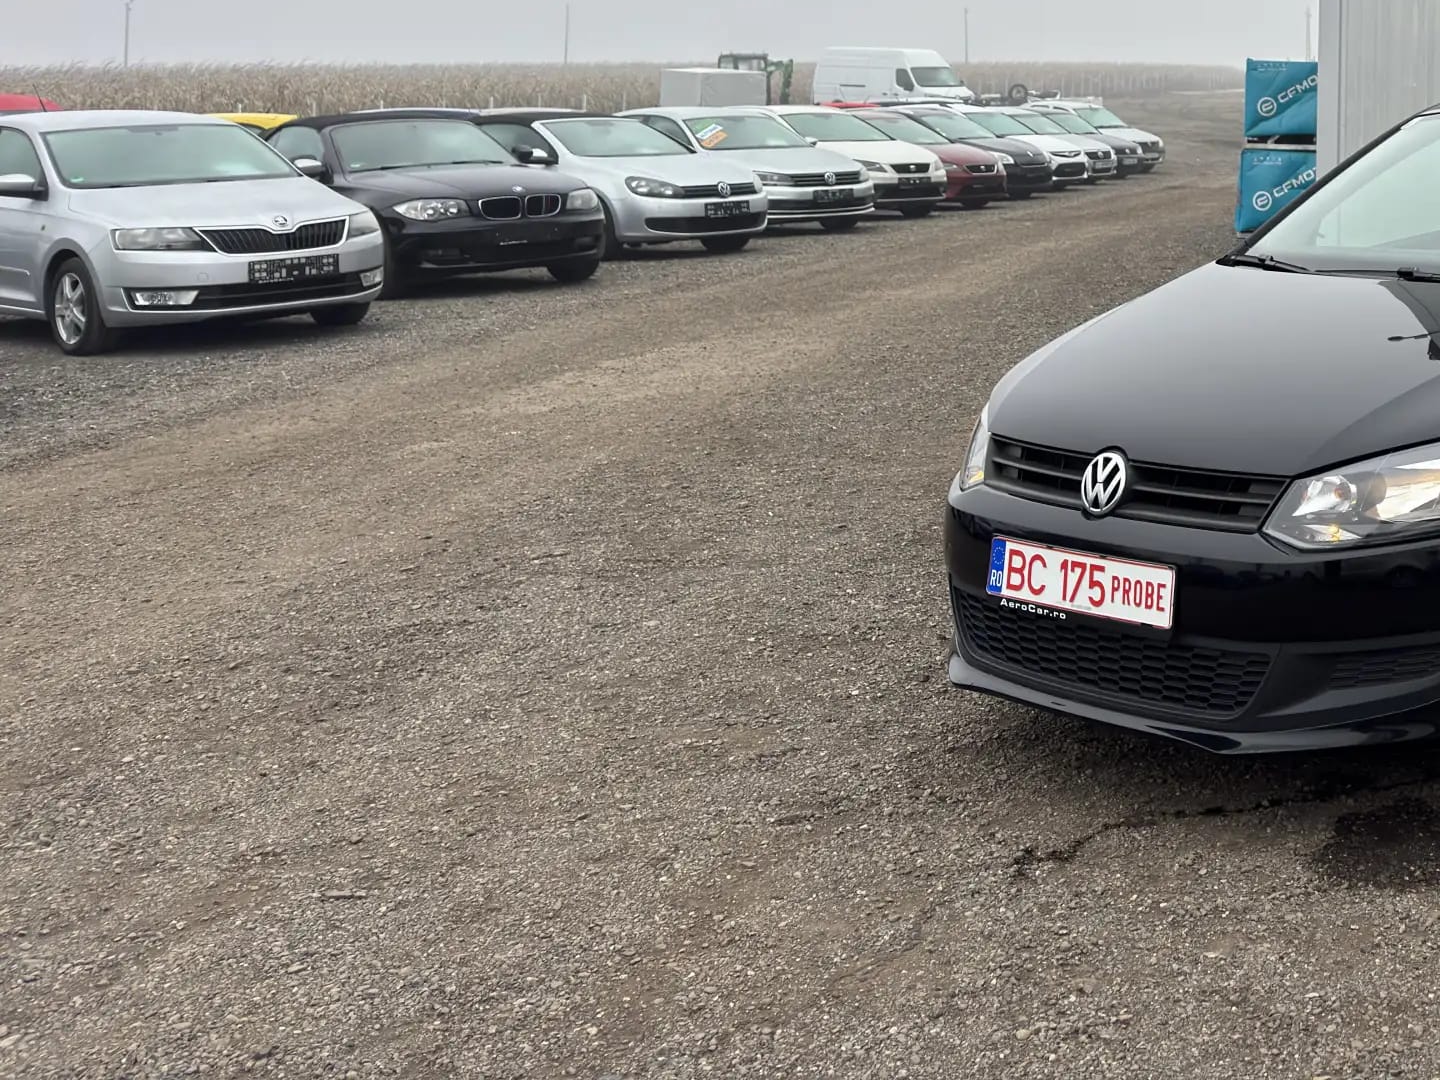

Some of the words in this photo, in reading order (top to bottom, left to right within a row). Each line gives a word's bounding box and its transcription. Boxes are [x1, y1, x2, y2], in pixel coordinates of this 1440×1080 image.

[1277, 73, 1318, 103] CFMO
[1273, 167, 1316, 198] CFMO
[989, 569, 1003, 587] RO
[1006, 549, 1047, 595] BC
[1060, 558, 1106, 608] 175
[1110, 575, 1167, 612] PROBE
[1000, 598, 1067, 620] AeroCar.ro
